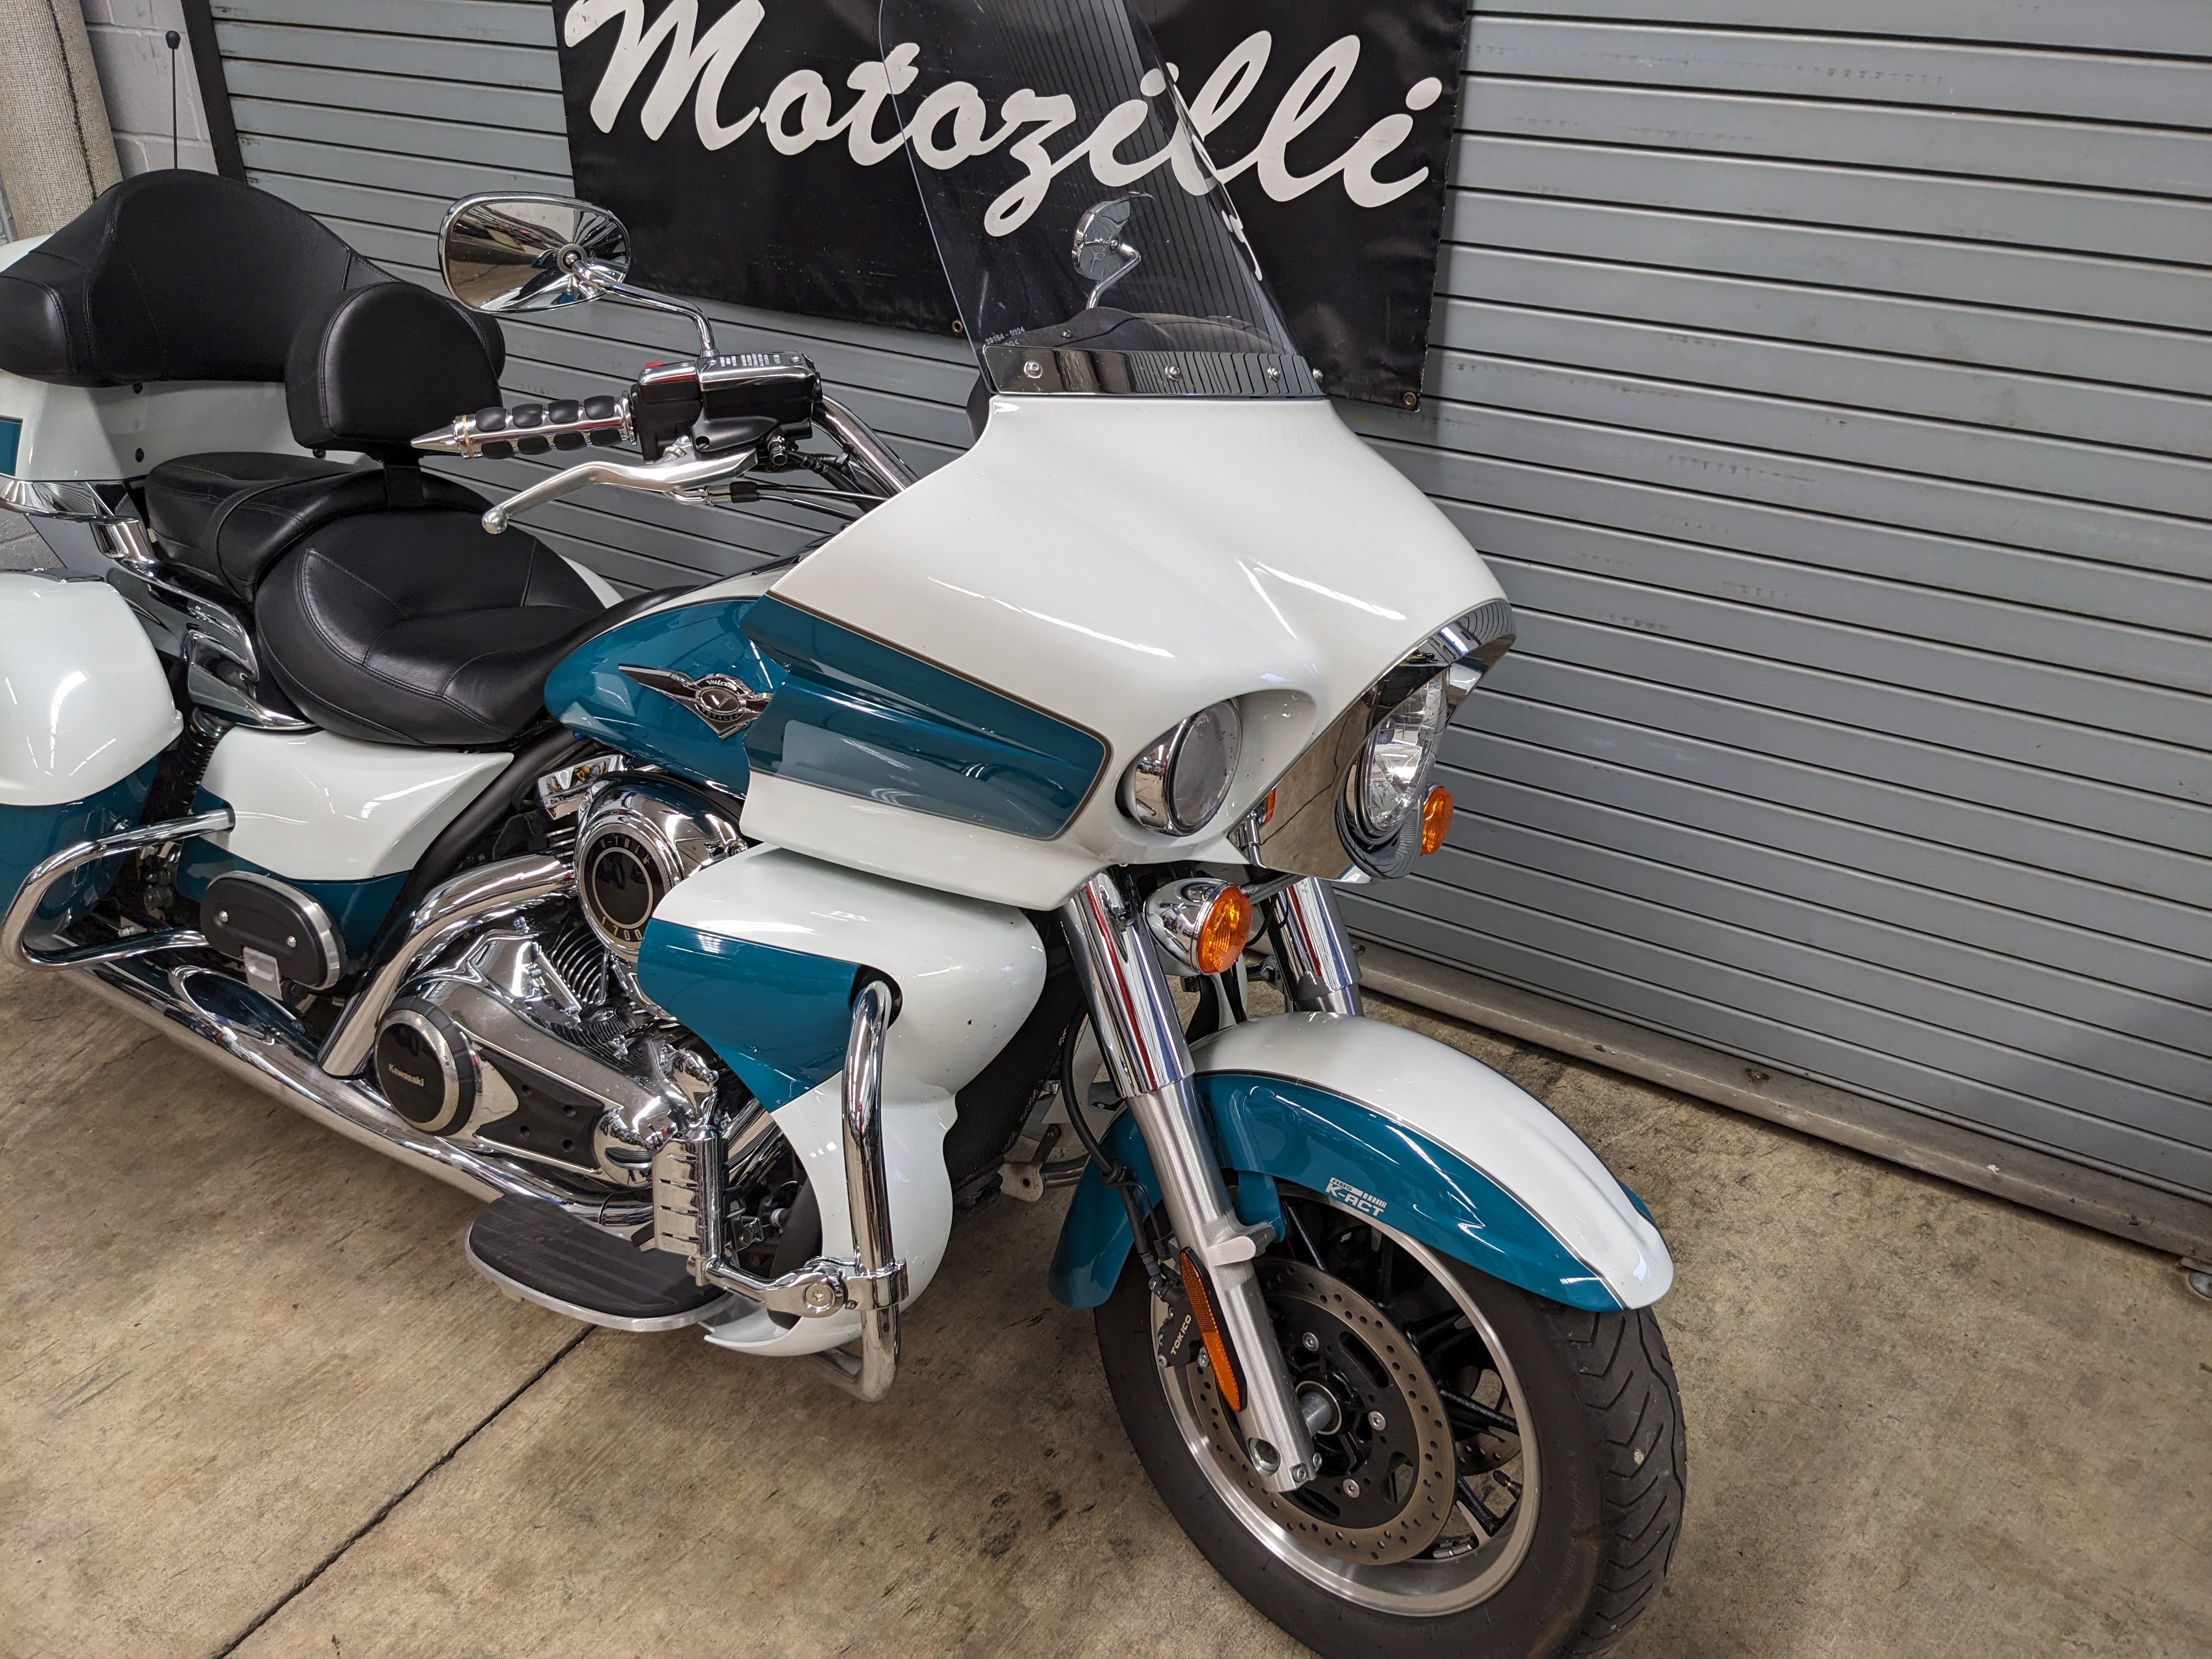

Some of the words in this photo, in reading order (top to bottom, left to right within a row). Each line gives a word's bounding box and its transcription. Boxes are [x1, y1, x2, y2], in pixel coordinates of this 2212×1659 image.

[565, 0, 1442, 237] Motozilli
[706, 679, 737, 691] Vulcan
[702, 708, 740, 721] VOYAGER
[602, 916, 643, 941] 1700
[389, 1063, 424, 1087] Kawasaki
[1331, 1179, 1353, 1191] ABS
[1325, 1182, 1384, 1216] K-ACT
[1170, 1314, 1192, 1355] TOKICO
